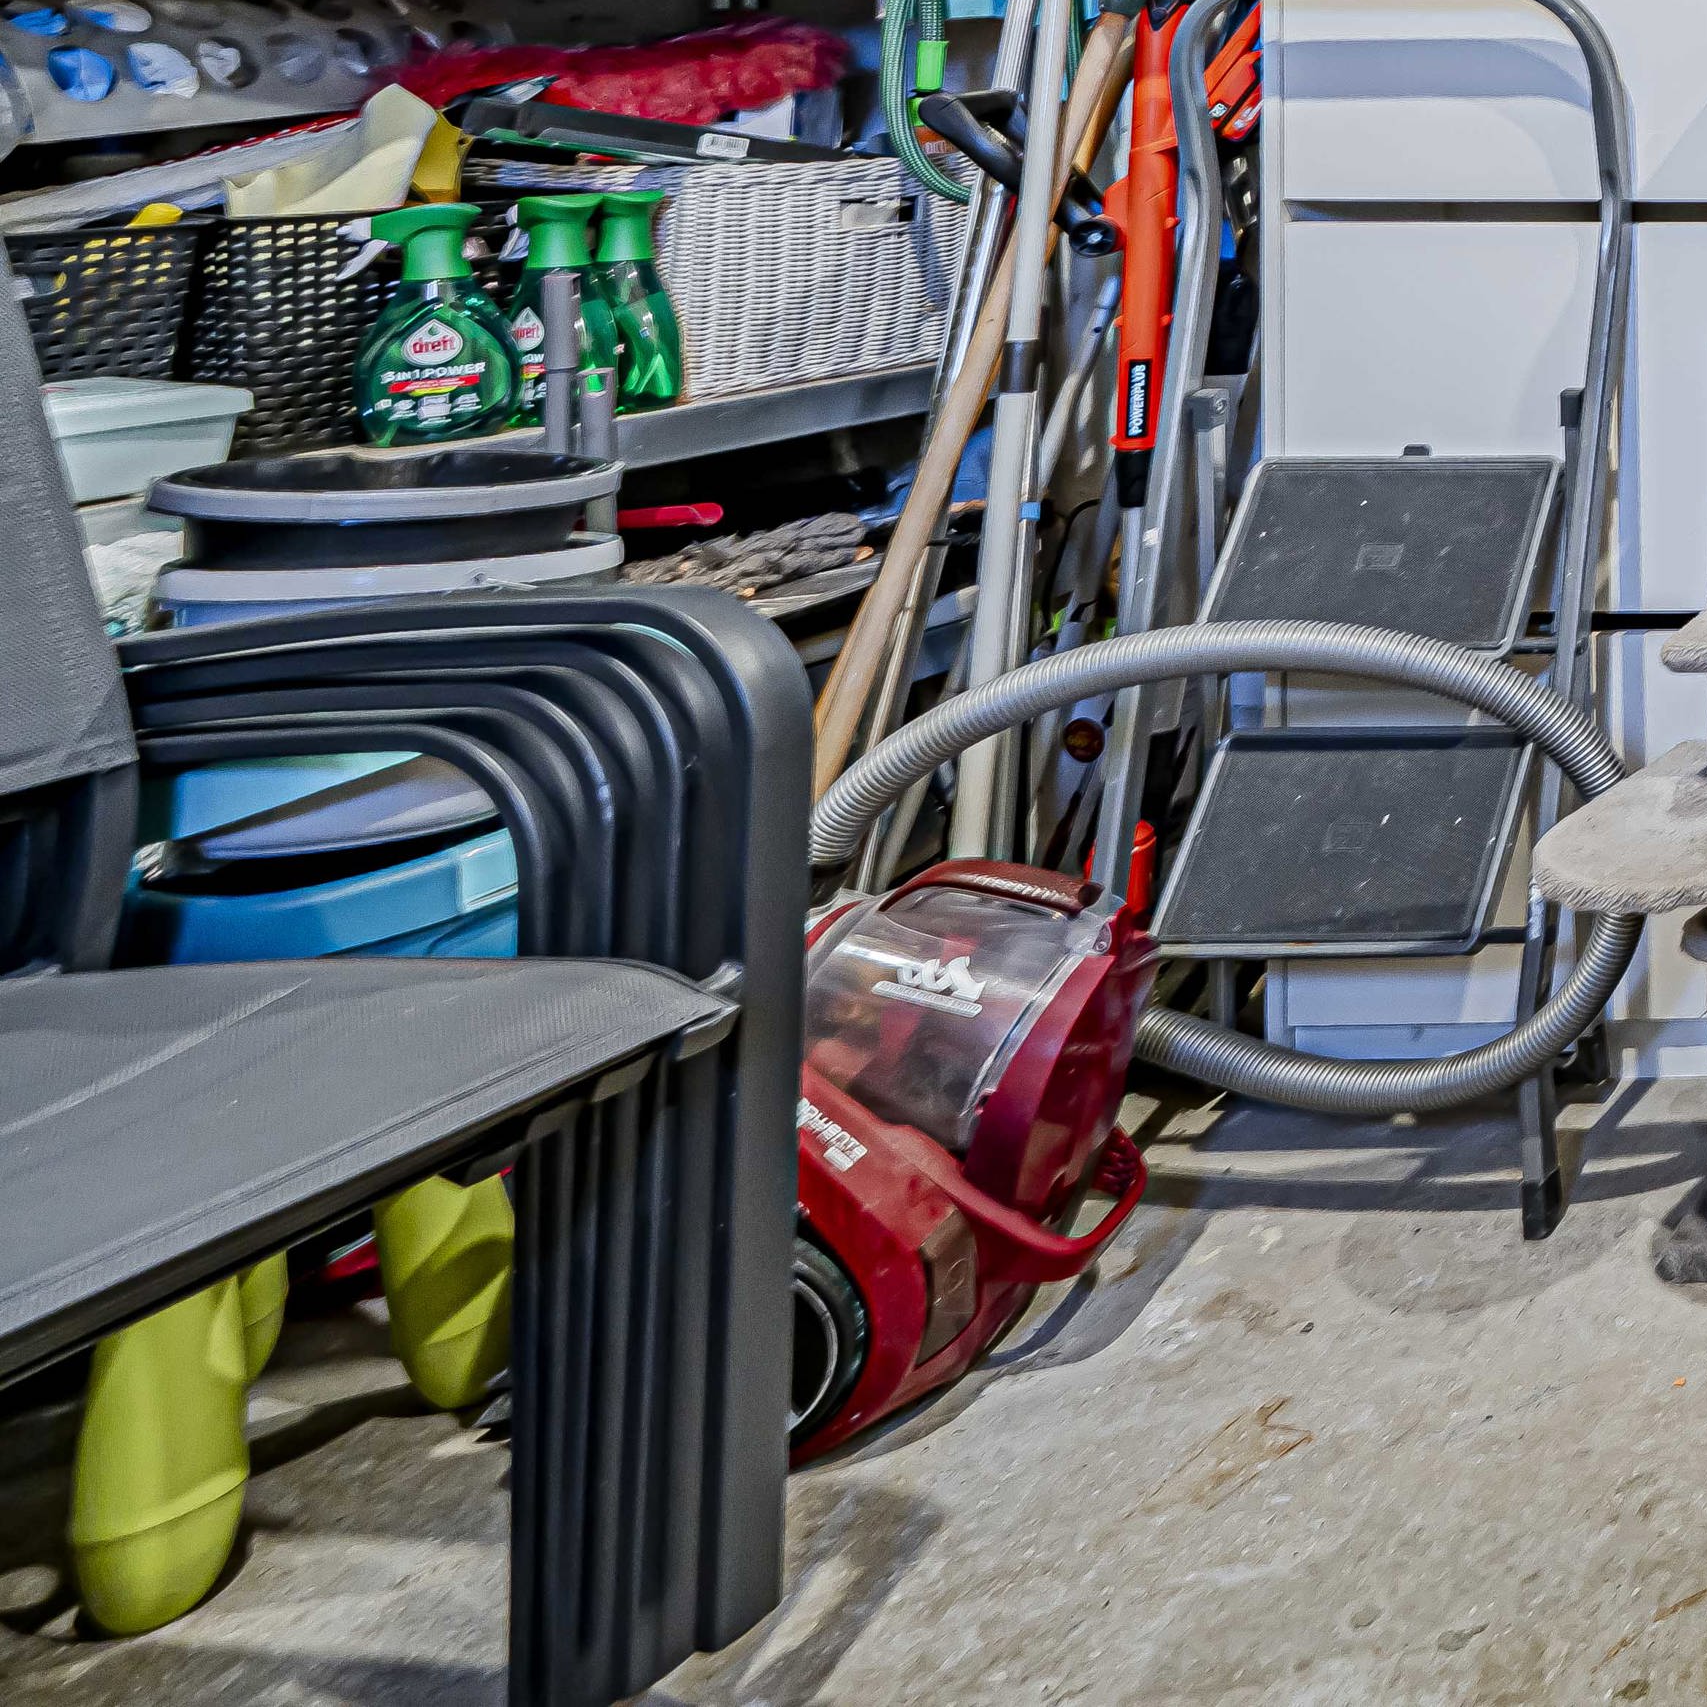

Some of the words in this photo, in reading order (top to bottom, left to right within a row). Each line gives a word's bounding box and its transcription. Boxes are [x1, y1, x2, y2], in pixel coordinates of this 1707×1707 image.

[412, 334, 458, 354] dreft
[420, 361, 486, 379] POWER
[1129, 363, 1147, 436] POWERPLUS
